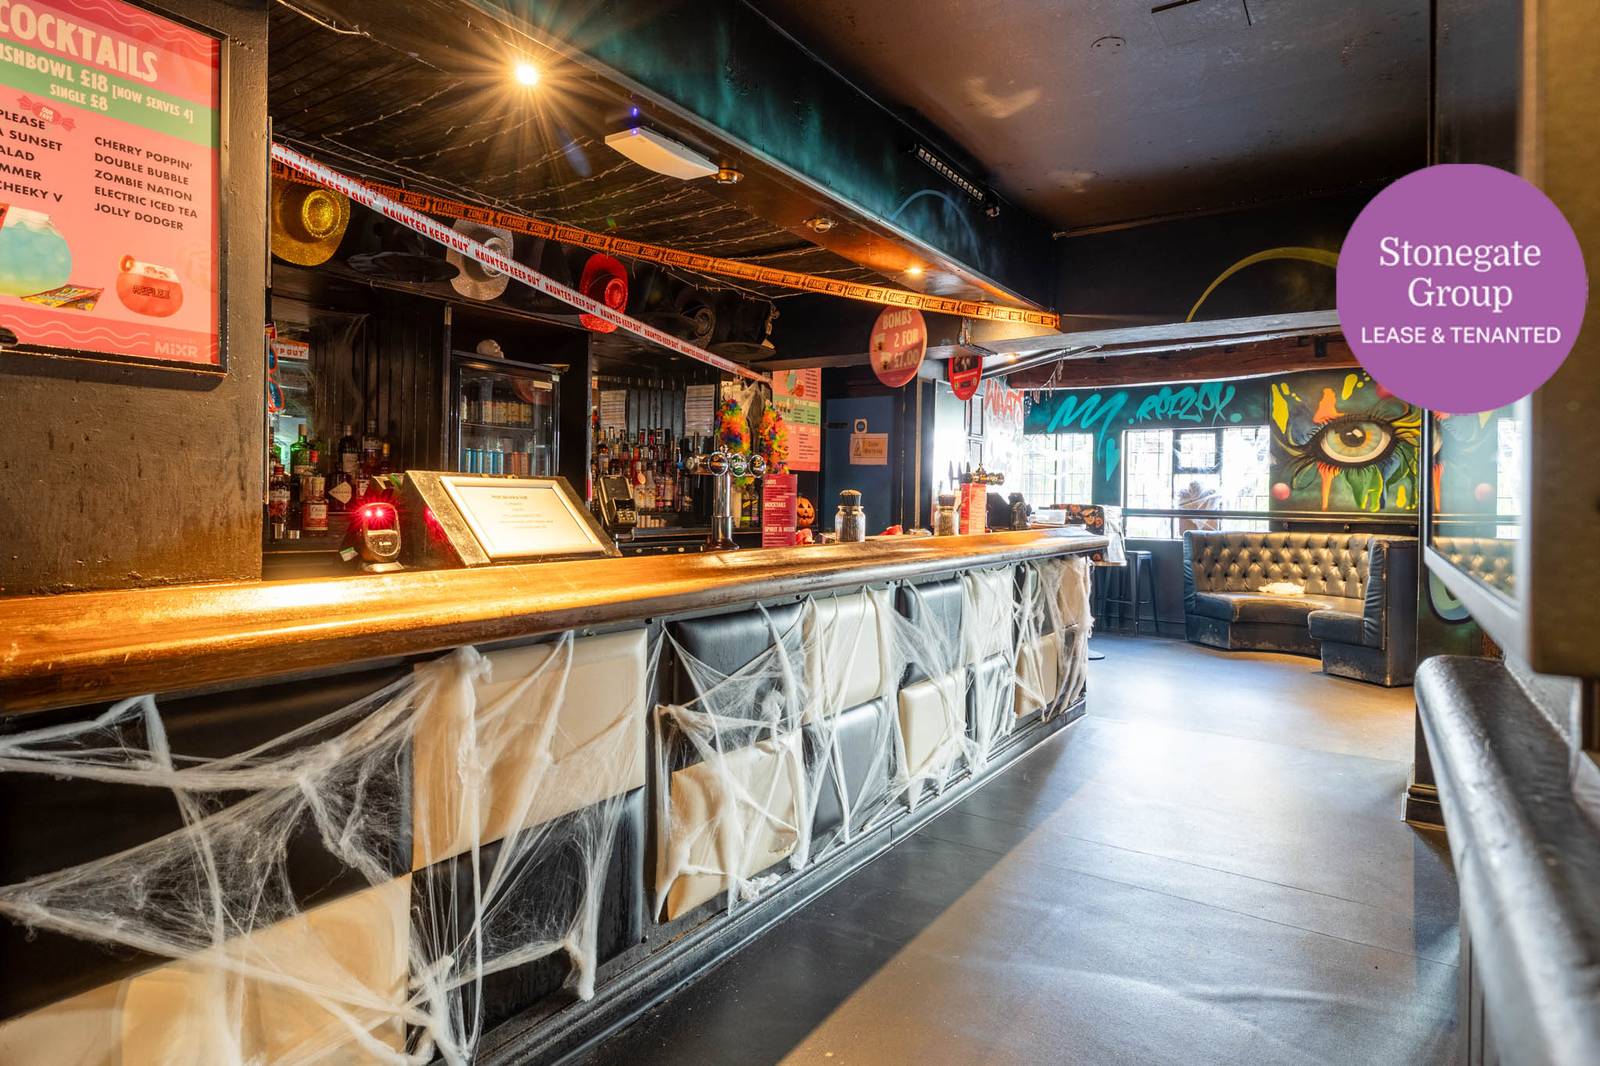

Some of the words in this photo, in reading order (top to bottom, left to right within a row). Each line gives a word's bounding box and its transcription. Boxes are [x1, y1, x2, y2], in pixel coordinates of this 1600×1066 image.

[50, 84, 86, 104] SINGLE
[90, 95, 108, 111] £8
[80, 68, 109, 92] £18
[112, 84, 143, 104] [NOW
[146, 96, 180, 116] SERVES
[183, 109, 194, 124] 4]
[9, 130, 63, 151] SUNSET
[94, 136, 142, 156] CHERRY
[146, 151, 192, 170] POPPIN'
[94, 153, 143, 173] DOUBLE
[147, 167, 189, 185] BUBBLE
[0, 181, 48, 199] HEEKY
[53, 193, 63, 202] V
[94, 169, 143, 189] ZOMBIE
[147, 183, 192, 201] NATION
[94, 186, 147, 206] ELECTRIC
[150, 199, 175, 213] ICED
[178, 206, 198, 219] TEA
[436, 202, 464, 215] DANGER
[467, 208, 488, 220] ZONE!
[94, 203, 130, 218] JOLLY
[134, 212, 184, 230] DODGER
[383, 206, 428, 235] HAUNTED
[429, 227, 450, 244] KEEP
[451, 240, 468, 252] OUT
[501, 215, 528, 227] DANGER
[475, 249, 509, 272] HAUNTED
[510, 265, 527, 280] KEEP
[527, 275, 540, 287] OUT
[882, 310, 913, 330] BOMBS
[894, 332, 900, 347] 2
[902, 329, 919, 346] FOR
[894, 350, 919, 368] £7.00
